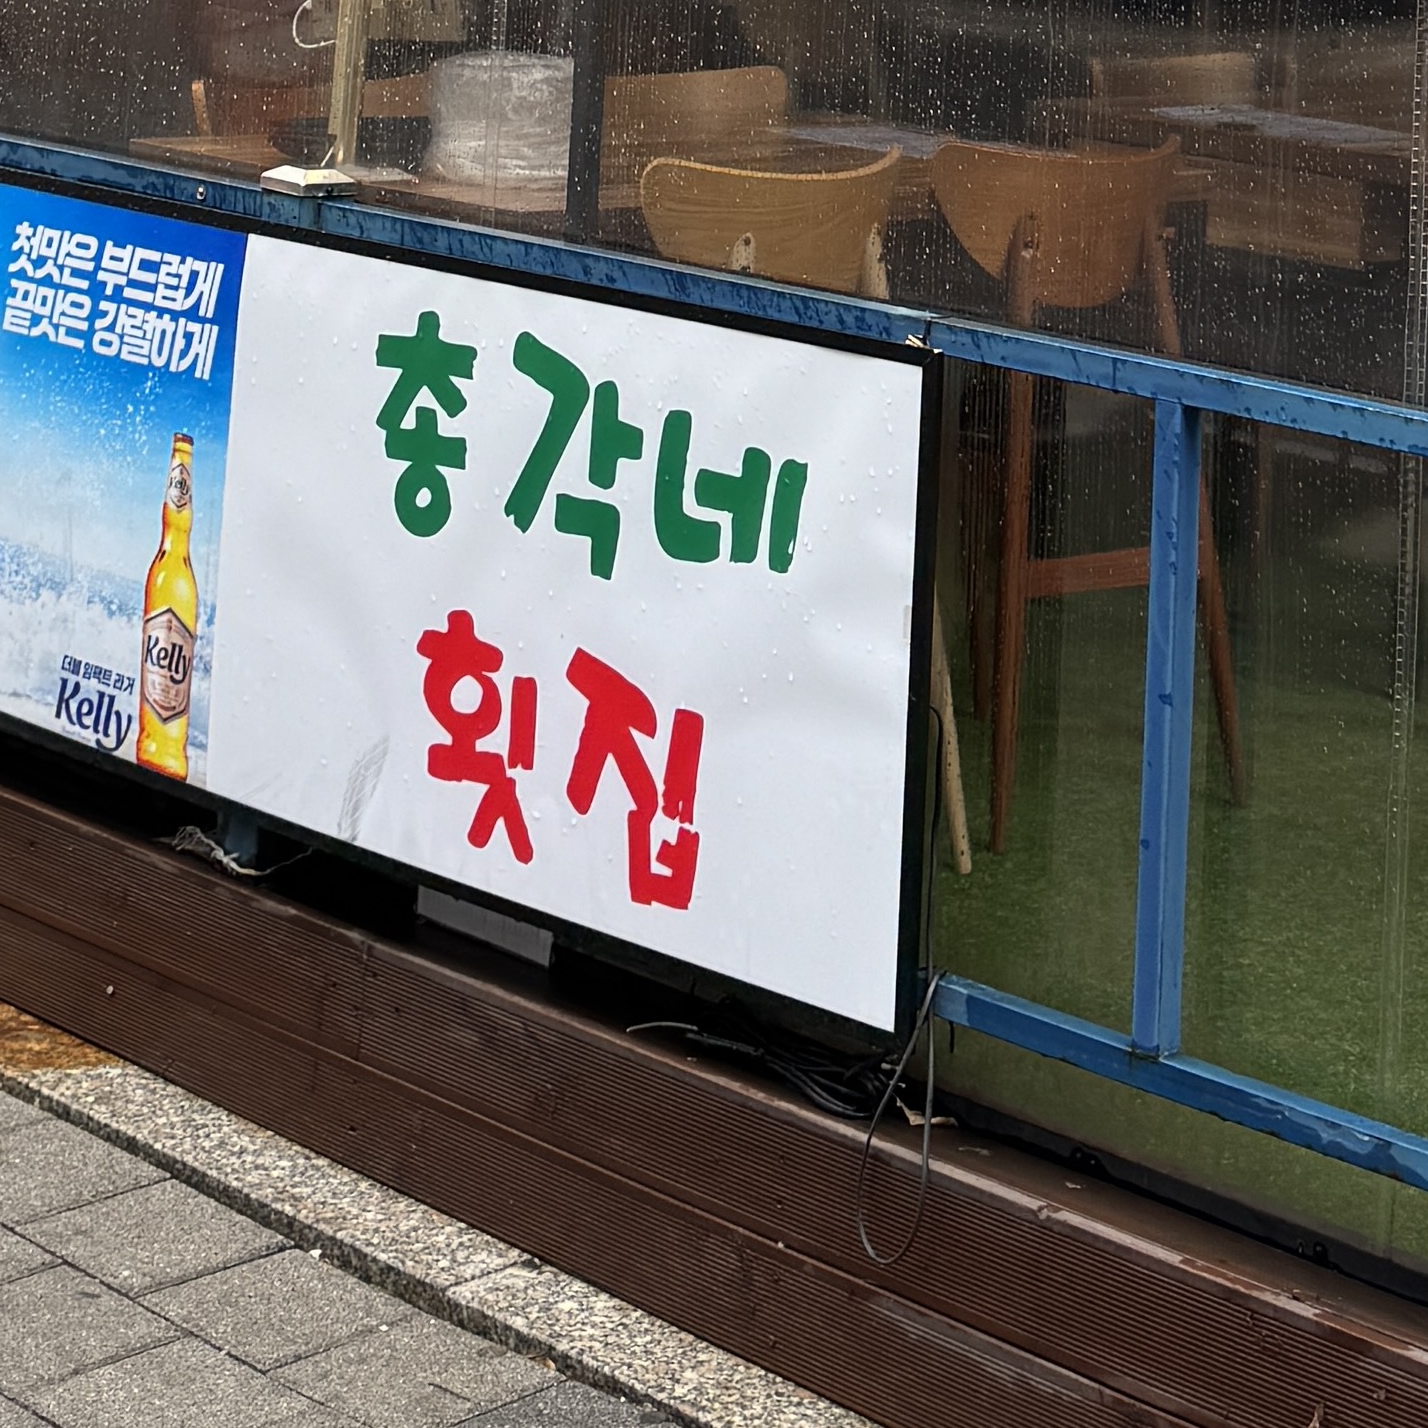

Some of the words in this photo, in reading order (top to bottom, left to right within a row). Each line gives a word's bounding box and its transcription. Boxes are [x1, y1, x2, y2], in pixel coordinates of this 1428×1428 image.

[7, 220, 99, 290] 첫맛은
[96, 239, 225, 319] 부드럽게
[2, 277, 93, 350] 끝맛은
[91, 299, 220, 381] 강렬하게
[375, 310, 809, 581] 총각네
[113, 672, 137, 696] 라거
[144, 634, 192, 686] Kelly
[54, 676, 133, 754] Kelly
[416, 609, 705, 911] 횟집
